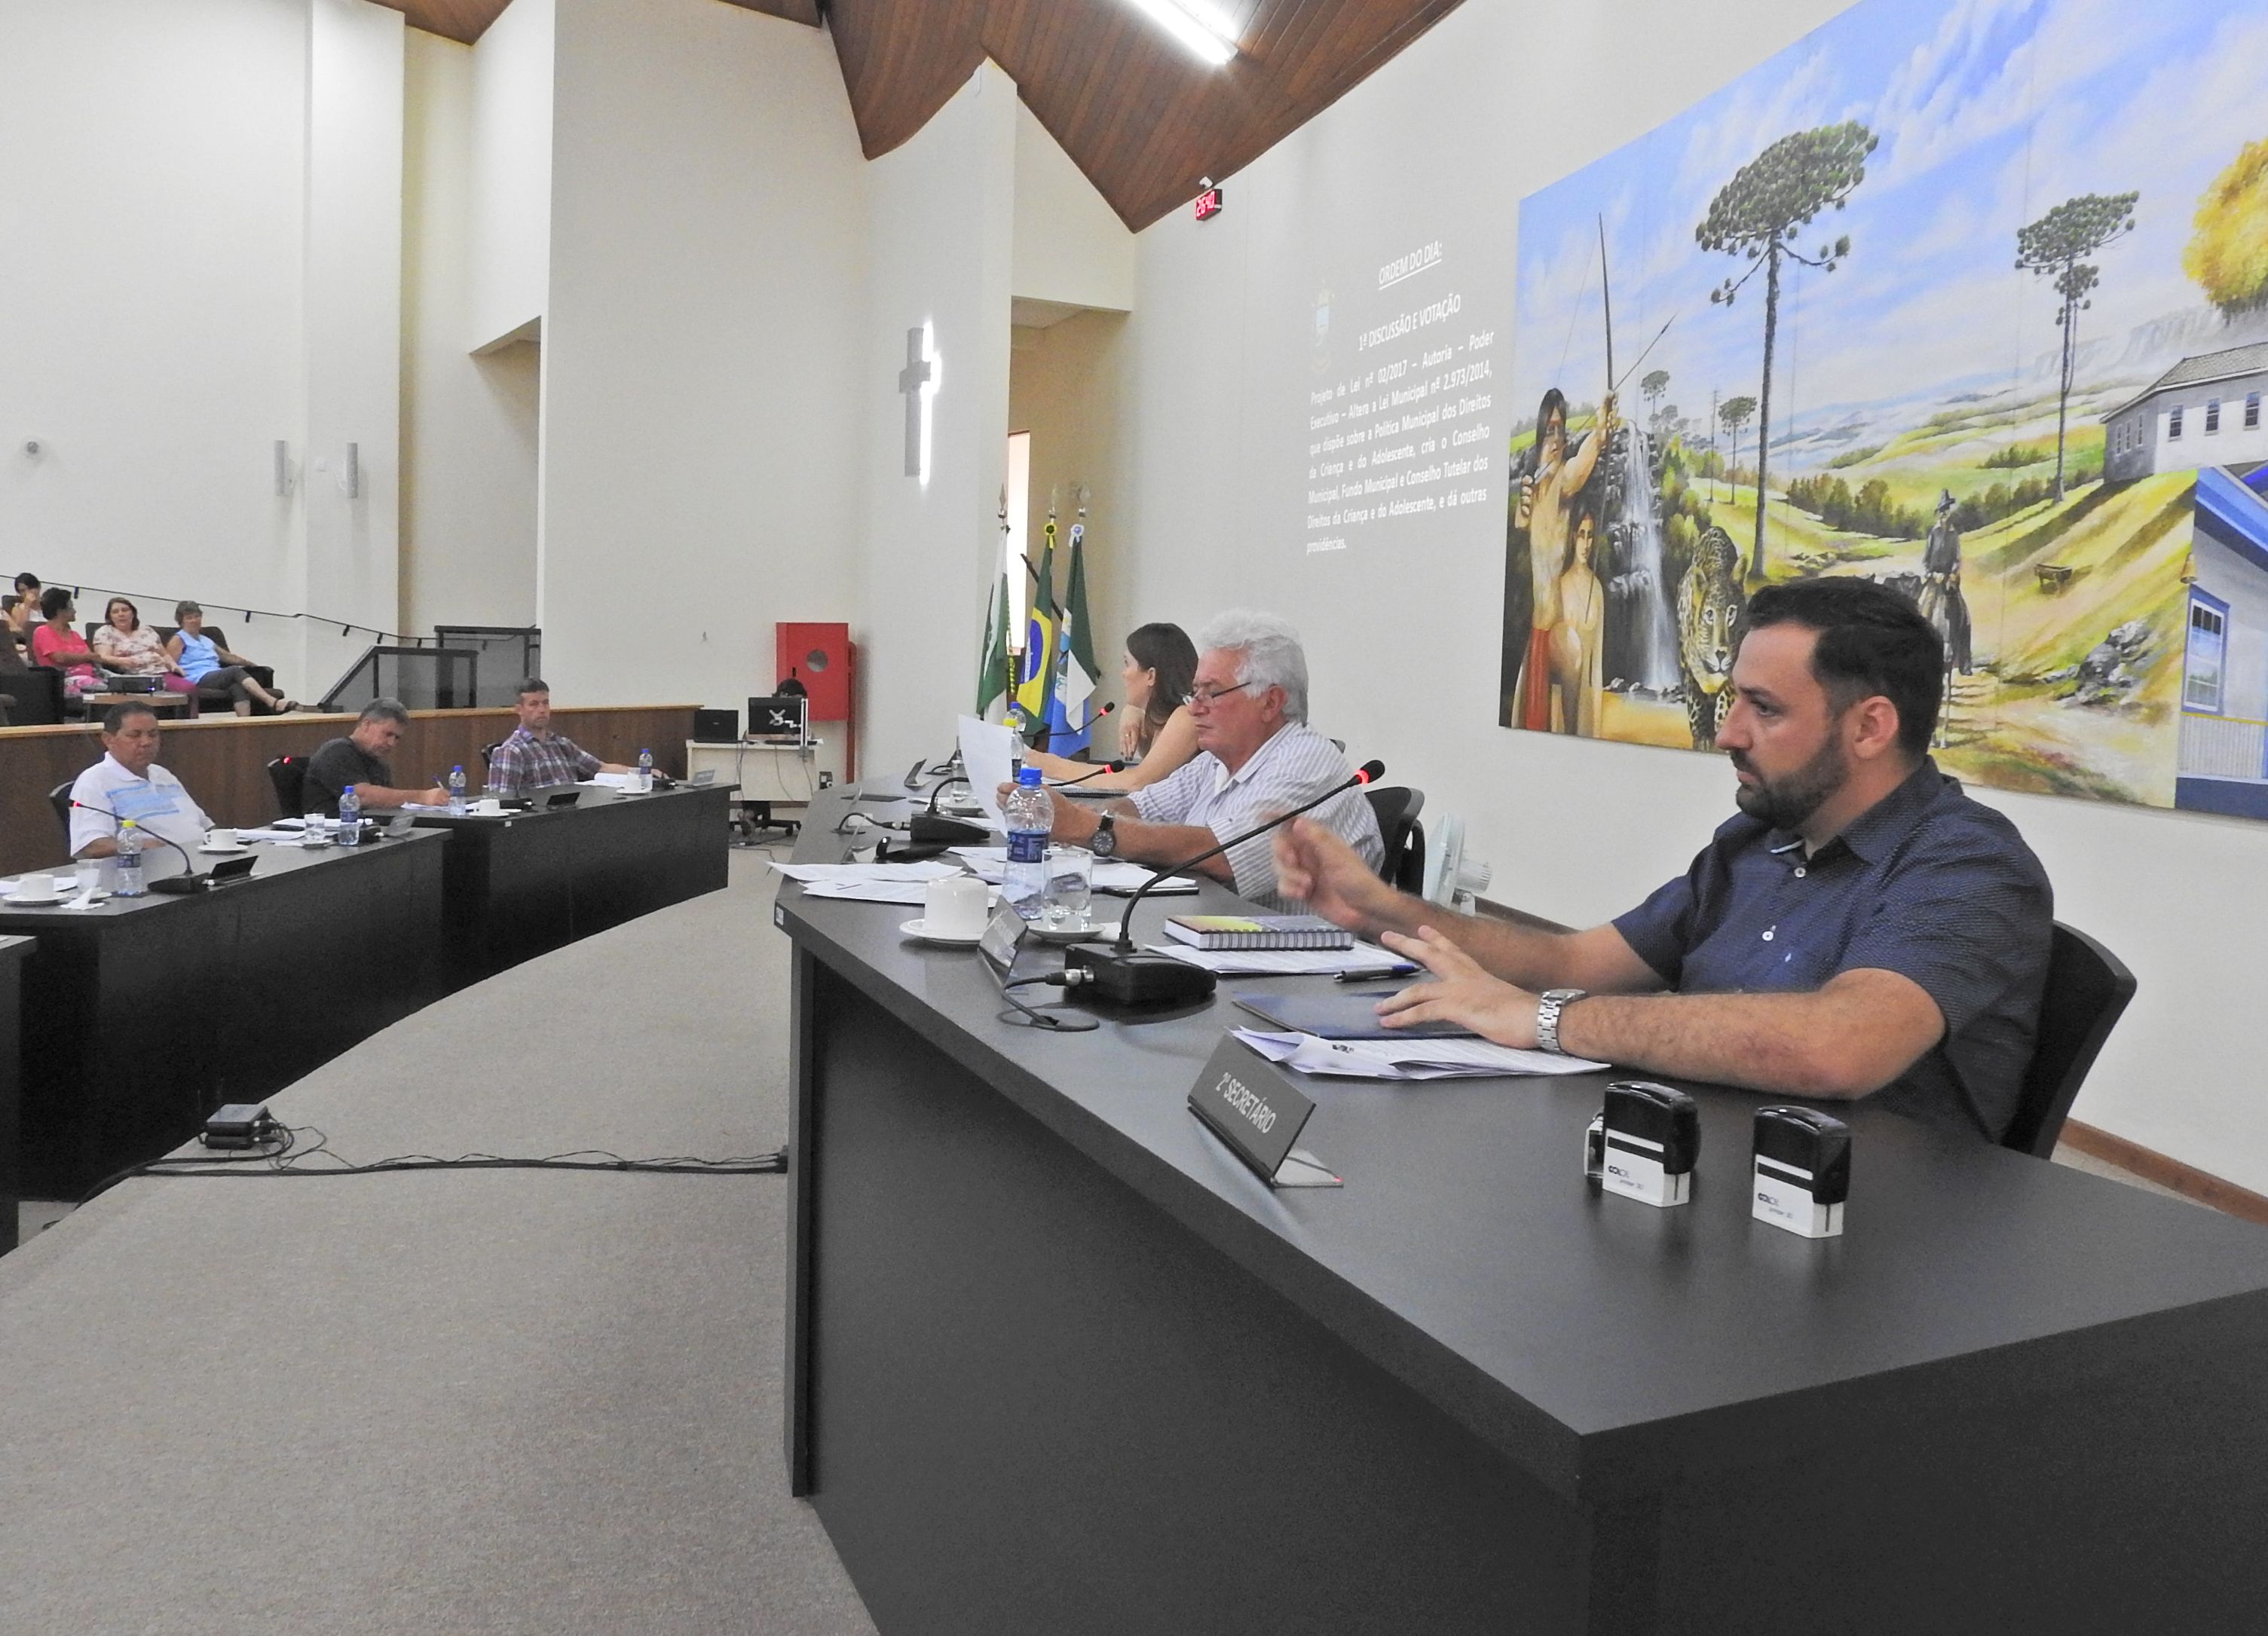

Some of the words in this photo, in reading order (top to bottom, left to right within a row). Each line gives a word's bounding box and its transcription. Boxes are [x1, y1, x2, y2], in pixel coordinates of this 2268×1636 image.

[1379, 255, 1408, 285] ORDEM
[1409, 249, 1422, 271] DO
[1424, 241, 1443, 264] DIA:
[1359, 333, 1367, 351] 1ª
[1369, 313, 1411, 347] DISCUSSÃO
[1413, 312, 1418, 330] E
[1419, 292, 1461, 326] VOTAÇÃO
[1311, 411, 1339, 430] Executivo
[1348, 404, 1369, 419] Altera
[1372, 401, 1376, 413] a
[1379, 393, 1388, 410] Lei
[1391, 380, 1428, 406] Municipal
[1443, 359, 1492, 390] 2.973/2014,
[1312, 388, 1333, 406] Projeto
[1337, 381, 1345, 397] de
[1351, 377, 1360, 393] Lei
[1378, 359, 1407, 384] 02/2017
[1422, 344, 1452, 369] Autoria
[1469, 330, 1494, 351] Poder
[1308, 465, 1316, 479] da
[1321, 461, 1343, 478] Criança
[1348, 460, 1353, 471] e
[1357, 454, 1367, 469] do
[1372, 443, 1416, 466] Adolescente,
[1422, 437, 1435, 454] cria
[1441, 437, 1447, 449] o
[1452, 422, 1489, 446] Conselho
[1310, 443, 1321, 458] que
[1323, 434, 1345, 454] dispõe
[1346, 430, 1365, 446] sobre
[1368, 430, 1372, 440] a
[1375, 420, 1399, 439] Política
[1402, 405, 1440, 431] Municipal
[1442, 402, 1456, 420] dos
[1459, 393, 1491, 416] Direitos
[1308, 485, 1340, 504] Municipal,
[1342, 481, 1363, 498] Fundo
[1364, 473, 1399, 494] Municipal
[1399, 475, 1405, 487] e
[1406, 464, 1441, 485] Conselho
[1443, 458, 1471, 478] Tutelar
[1473, 454, 1489, 472] dos
[1307, 514, 1331, 529] Direitos
[1333, 511, 1341, 524] da
[1343, 508, 1368, 524] Criança
[1370, 508, 1375, 519] e
[1378, 502, 1387, 518] do
[1388, 496, 1437, 515] Adolescente,
[1439, 496, 1444, 508] e
[1447, 488, 1458, 506] dá
[1461, 488, 1487, 505] outras
[1307, 537, 1346, 555] providências.
[1223, 1078, 1277, 1133] SECRETÁRIO
